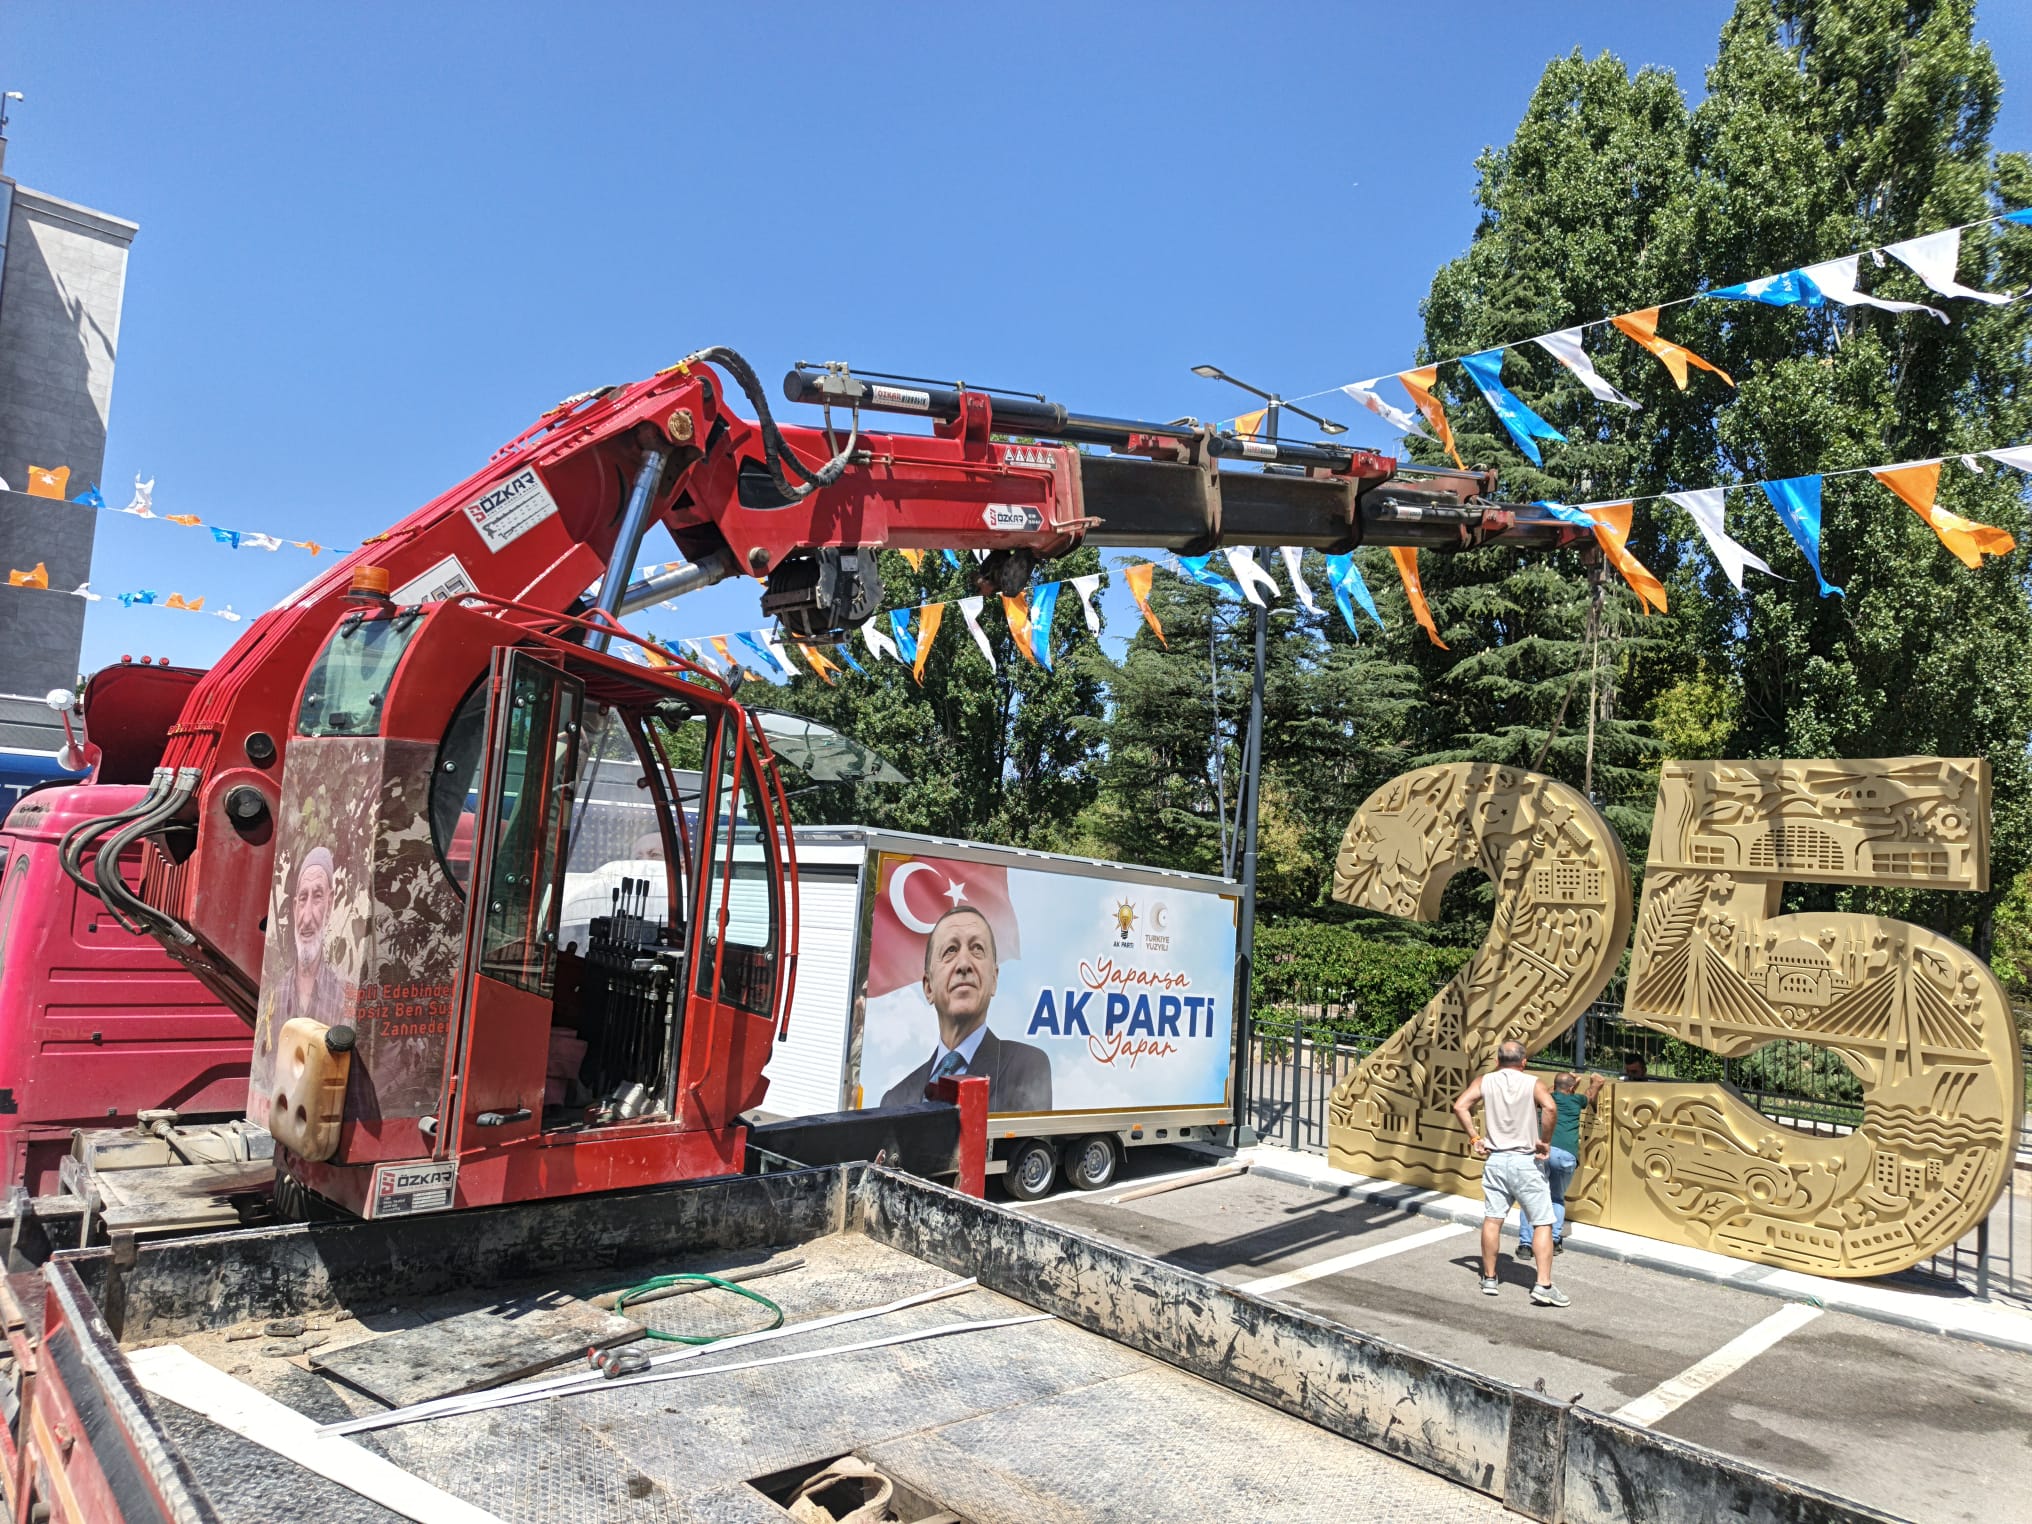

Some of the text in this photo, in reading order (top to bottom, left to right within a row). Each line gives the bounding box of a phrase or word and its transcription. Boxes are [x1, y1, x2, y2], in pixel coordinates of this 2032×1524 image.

[480, 471, 536, 513] ÖZKAR
[383, 983, 450, 999] Edebinde
[1080, 957, 1190, 994] Yaparsa
[395, 1003, 423, 1017] Ben
[1027, 989, 1094, 1036] AK
[1088, 1029, 1178, 1069] Yapar
[397, 1171, 453, 1188] ÖZKAR
